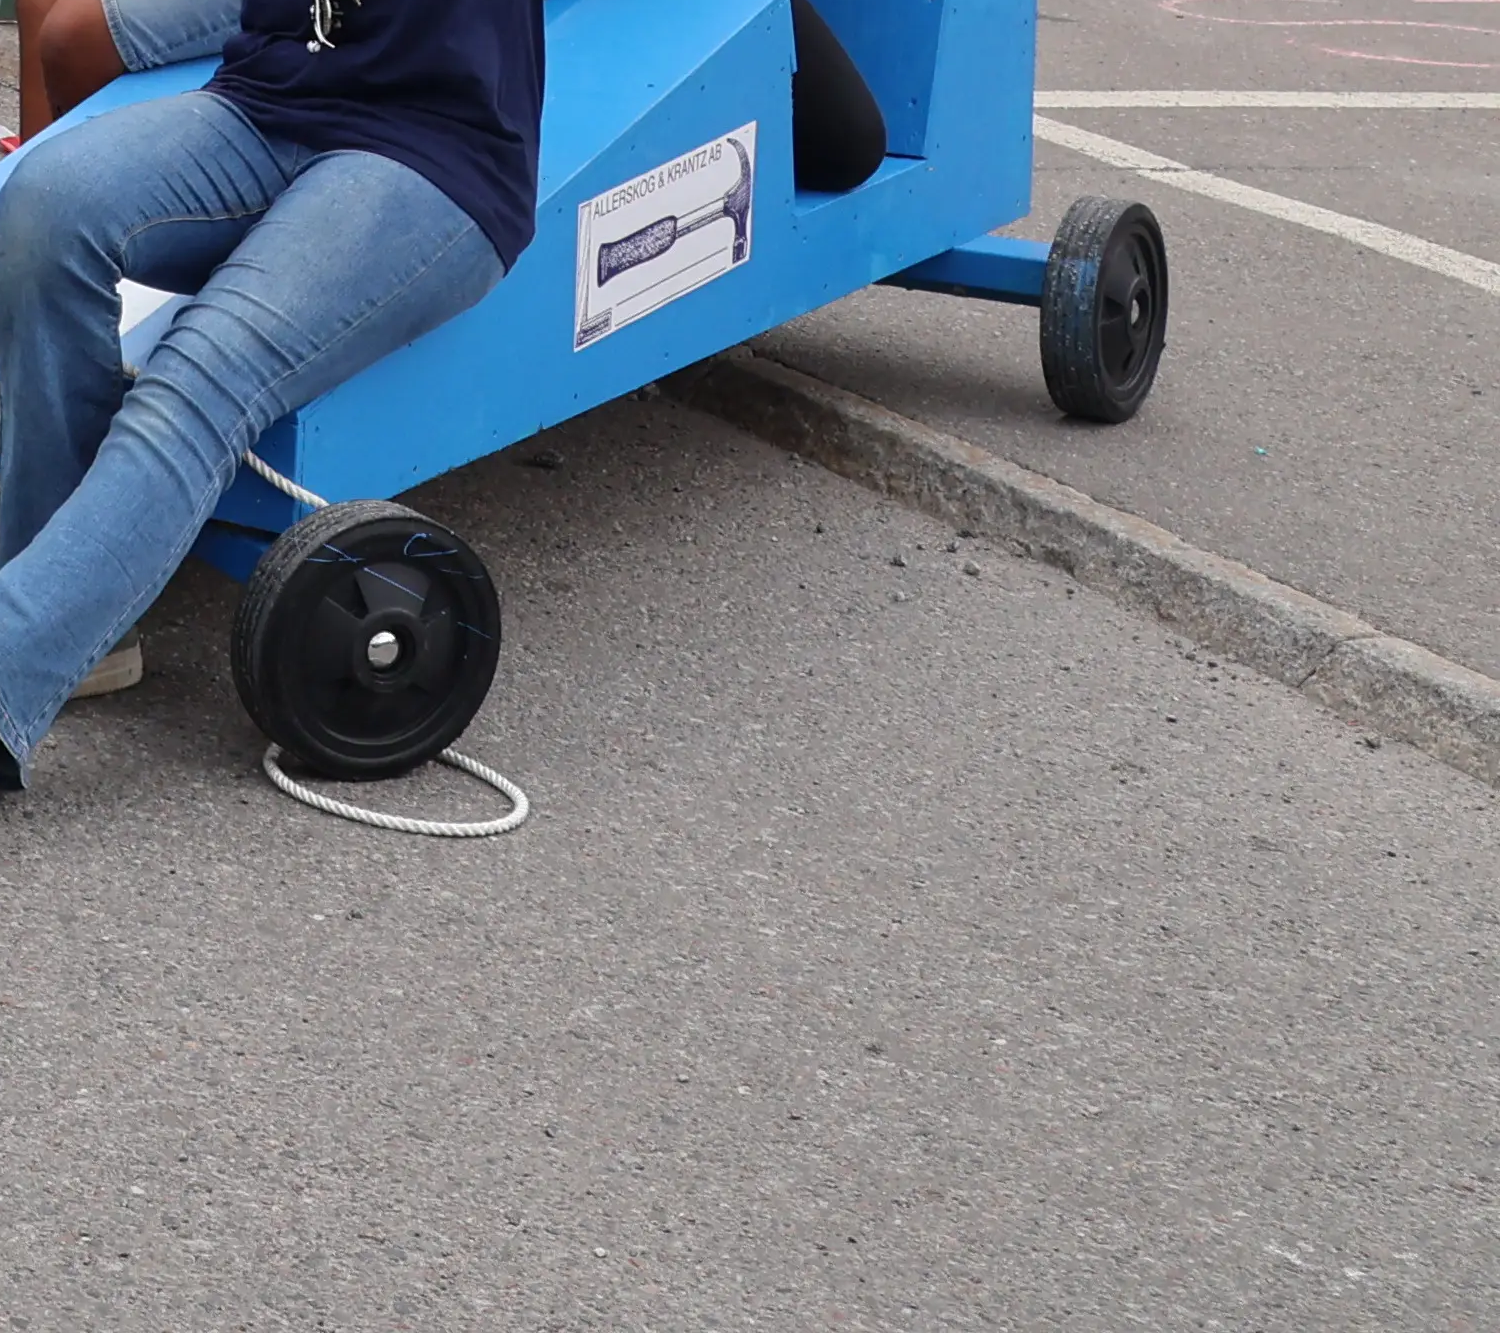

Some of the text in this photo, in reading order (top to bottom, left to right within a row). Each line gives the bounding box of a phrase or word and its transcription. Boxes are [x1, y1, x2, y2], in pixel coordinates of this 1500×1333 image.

[592, 143, 723, 221] ALLERSKOG & KRANTZ AB
